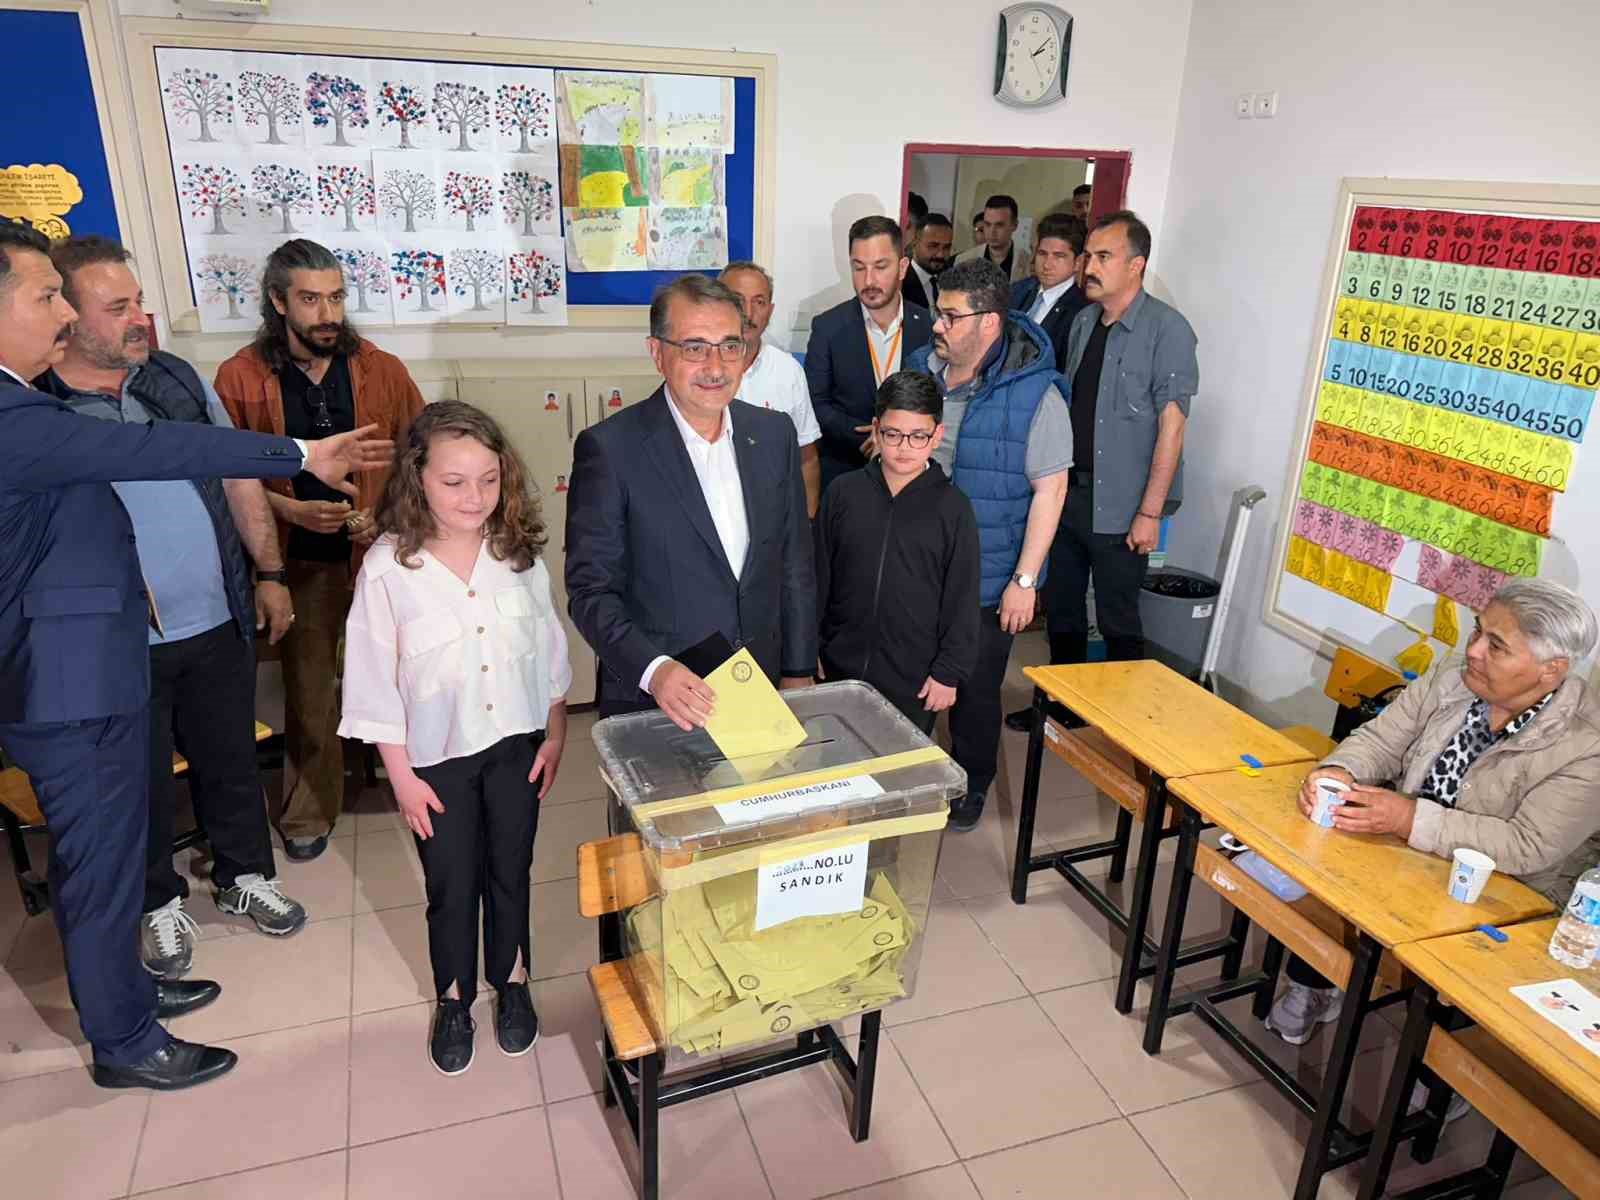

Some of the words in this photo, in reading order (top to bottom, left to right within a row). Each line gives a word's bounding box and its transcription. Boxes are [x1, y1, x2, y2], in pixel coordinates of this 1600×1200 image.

[1356, 232, 1367, 250] 2
[1378, 234, 1390, 253] 4
[1401, 236, 1414, 256] 6
[1424, 239, 1438, 259] 8
[1449, 240, 1472, 262] 10
[1477, 243, 1499, 265] 12
[1505, 246, 1528, 270] 14
[1534, 249, 1560, 273] 16
[1567, 251, 1593, 275] 18
[1347, 277, 1358, 294] 3
[1369, 280, 1381, 298] 6
[1391, 283, 1402, 301] 9
[1412, 286, 1430, 306] 12
[1438, 290, 1456, 311] 15
[1465, 294, 1486, 314] 18
[1492, 297, 1515, 319] 21
[1519, 300, 1547, 323] 24
[1550, 306, 1580, 328] 27
[1582, 309, 1600, 330] 3
[1339, 323, 1349, 338] 4
[1360, 325, 1371, 343] 8
[1379, 328, 1396, 348] 12
[1402, 332, 1420, 352] 16
[1423, 336, 1447, 357] 20
[1449, 340, 1473, 362] 24
[1477, 345, 1503, 367] 28
[1506, 351, 1533, 373] 32
[1535, 357, 1565, 380] 36
[1568, 362, 1600, 386] 40
[1331, 363, 1342, 380] 5
[1348, 367, 1367, 386] 10
[1370, 372, 1386, 392] 15
[1387, 378, 1411, 397] 20
[1413, 382, 1437, 403] 25
[1438, 387, 1464, 409] 30
[1464, 393, 1491, 415] 35
[1492, 399, 1520, 422] 40
[1521, 408, 1551, 431] 45
[1551, 414, 1583, 439] 50
[1322, 405, 1333, 421] 6
[1338, 410, 1360, 428] 12
[1360, 415, 1378, 434] 18
[1379, 420, 1402, 440] 24
[1403, 426, 1426, 447] 30
[1427, 433, 1452, 454] 36
[1453, 440, 1480, 461] 42
[1480, 448, 1506, 470] 48
[1506, 455, 1533, 480] 54
[1535, 465, 1565, 488] 60
[779, 871, 845, 893] SANDIK
